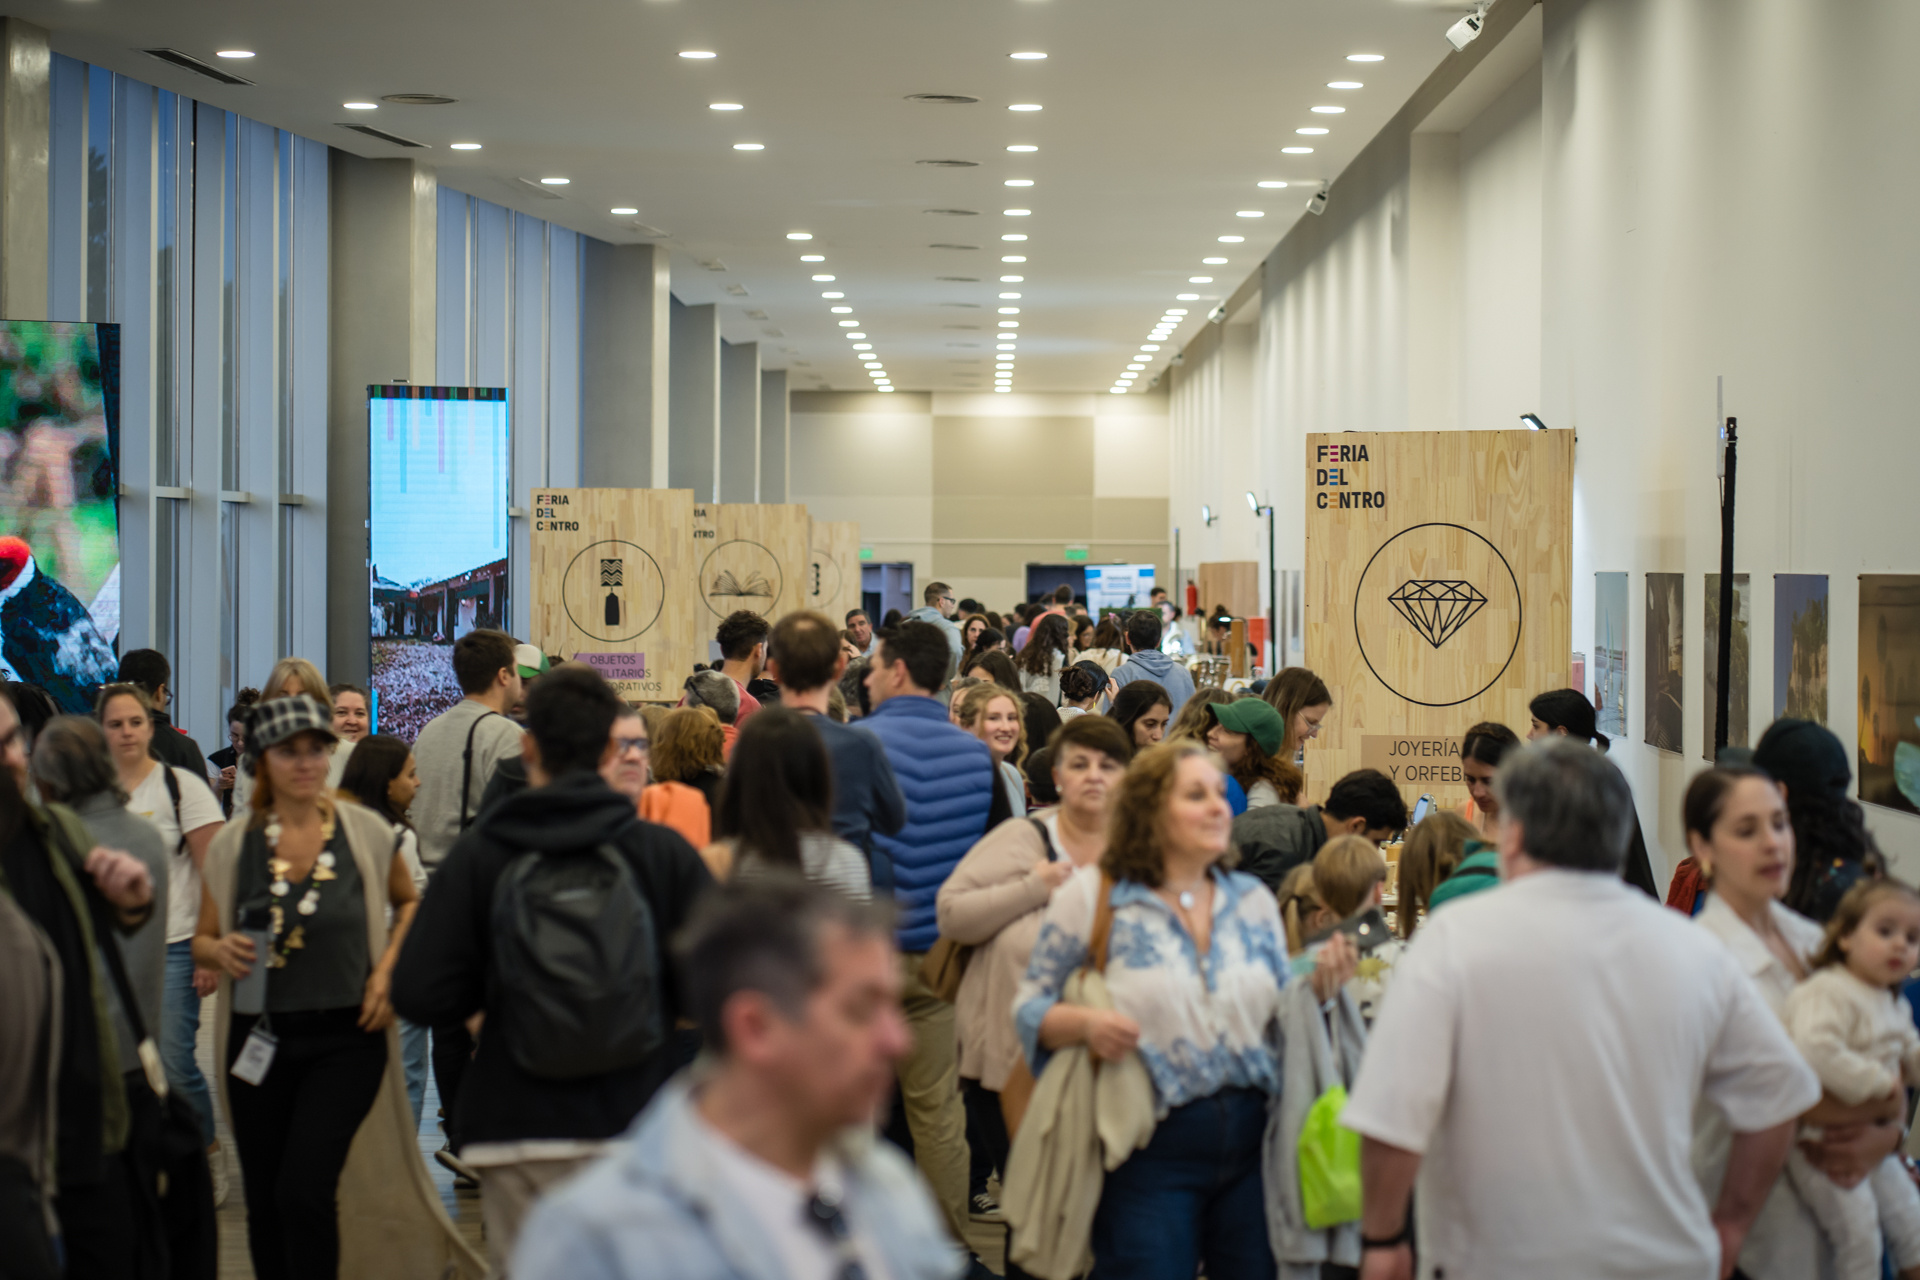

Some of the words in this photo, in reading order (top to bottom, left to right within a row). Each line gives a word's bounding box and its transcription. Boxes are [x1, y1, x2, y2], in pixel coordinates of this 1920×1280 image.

[1317, 445, 1369, 462] FERIA
[1317, 468, 1348, 486] DEL
[536, 494, 570, 505] FERIA
[1316, 491, 1385, 509] CENTRO
[536, 508, 556, 518] DEL
[536, 521, 579, 531] CENTRO
[589, 655, 637, 665] OBJETOS
[597, 668, 652, 678] TILITARIOS
[607, 681, 662, 692] ORATIVOS
[1388, 738, 1461, 757] JOYERÍA
[1388, 765, 1400, 780] Y
[1405, 765, 1467, 782] ORFEB
